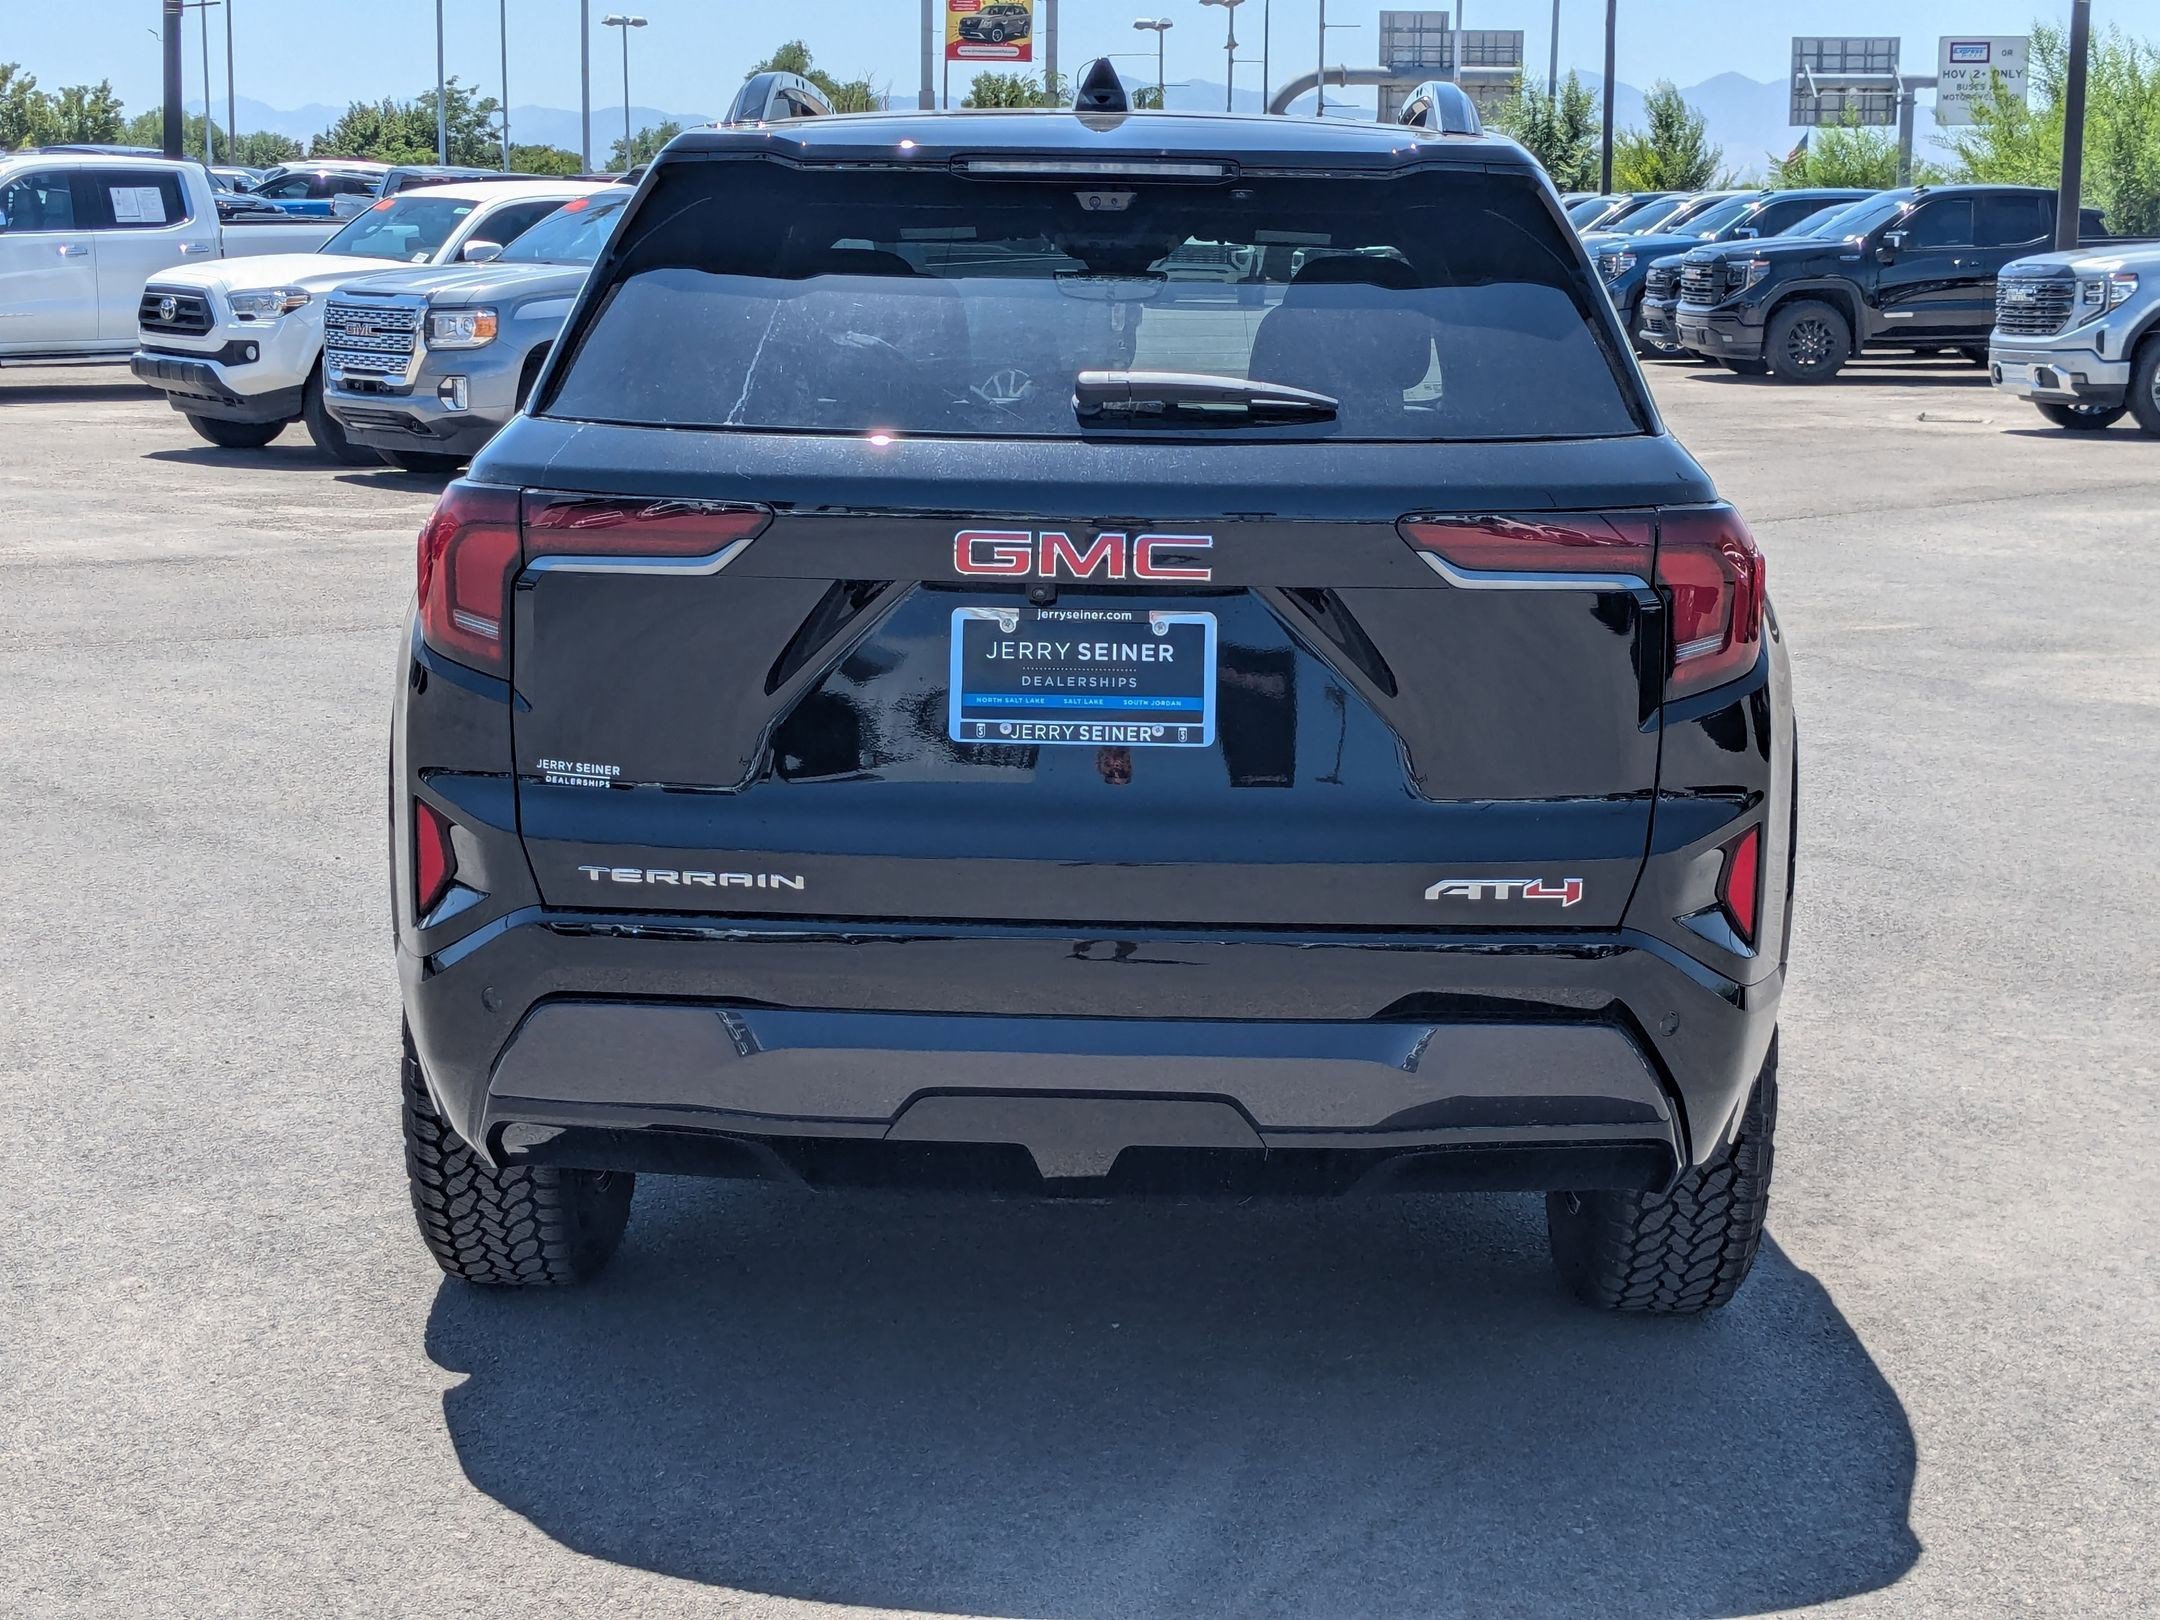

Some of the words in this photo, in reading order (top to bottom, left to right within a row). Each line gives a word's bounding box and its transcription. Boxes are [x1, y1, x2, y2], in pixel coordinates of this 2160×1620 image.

[1942, 70, 1966, 78] HOV
[1973, 70, 1986, 78] 2+
[345, 322, 380, 337] GMC
[954, 529, 1213, 581] GMC
[1037, 608, 1132, 621] jerryseiner.com
[986, 641, 1071, 660] JERRY
[1077, 642, 1174, 662] SEINER
[1021, 675, 1137, 688] DEALERSHIPS
[1010, 725, 1075, 740] JERRY
[1079, 726, 1151, 742] SEINER
[536, 758, 573, 771] JERRY
[576, 762, 620, 776] SEINER
[545, 775, 611, 789] DEALERSHIPS
[577, 865, 805, 890] TERRAIN
[1424, 878, 1583, 907] AT4
